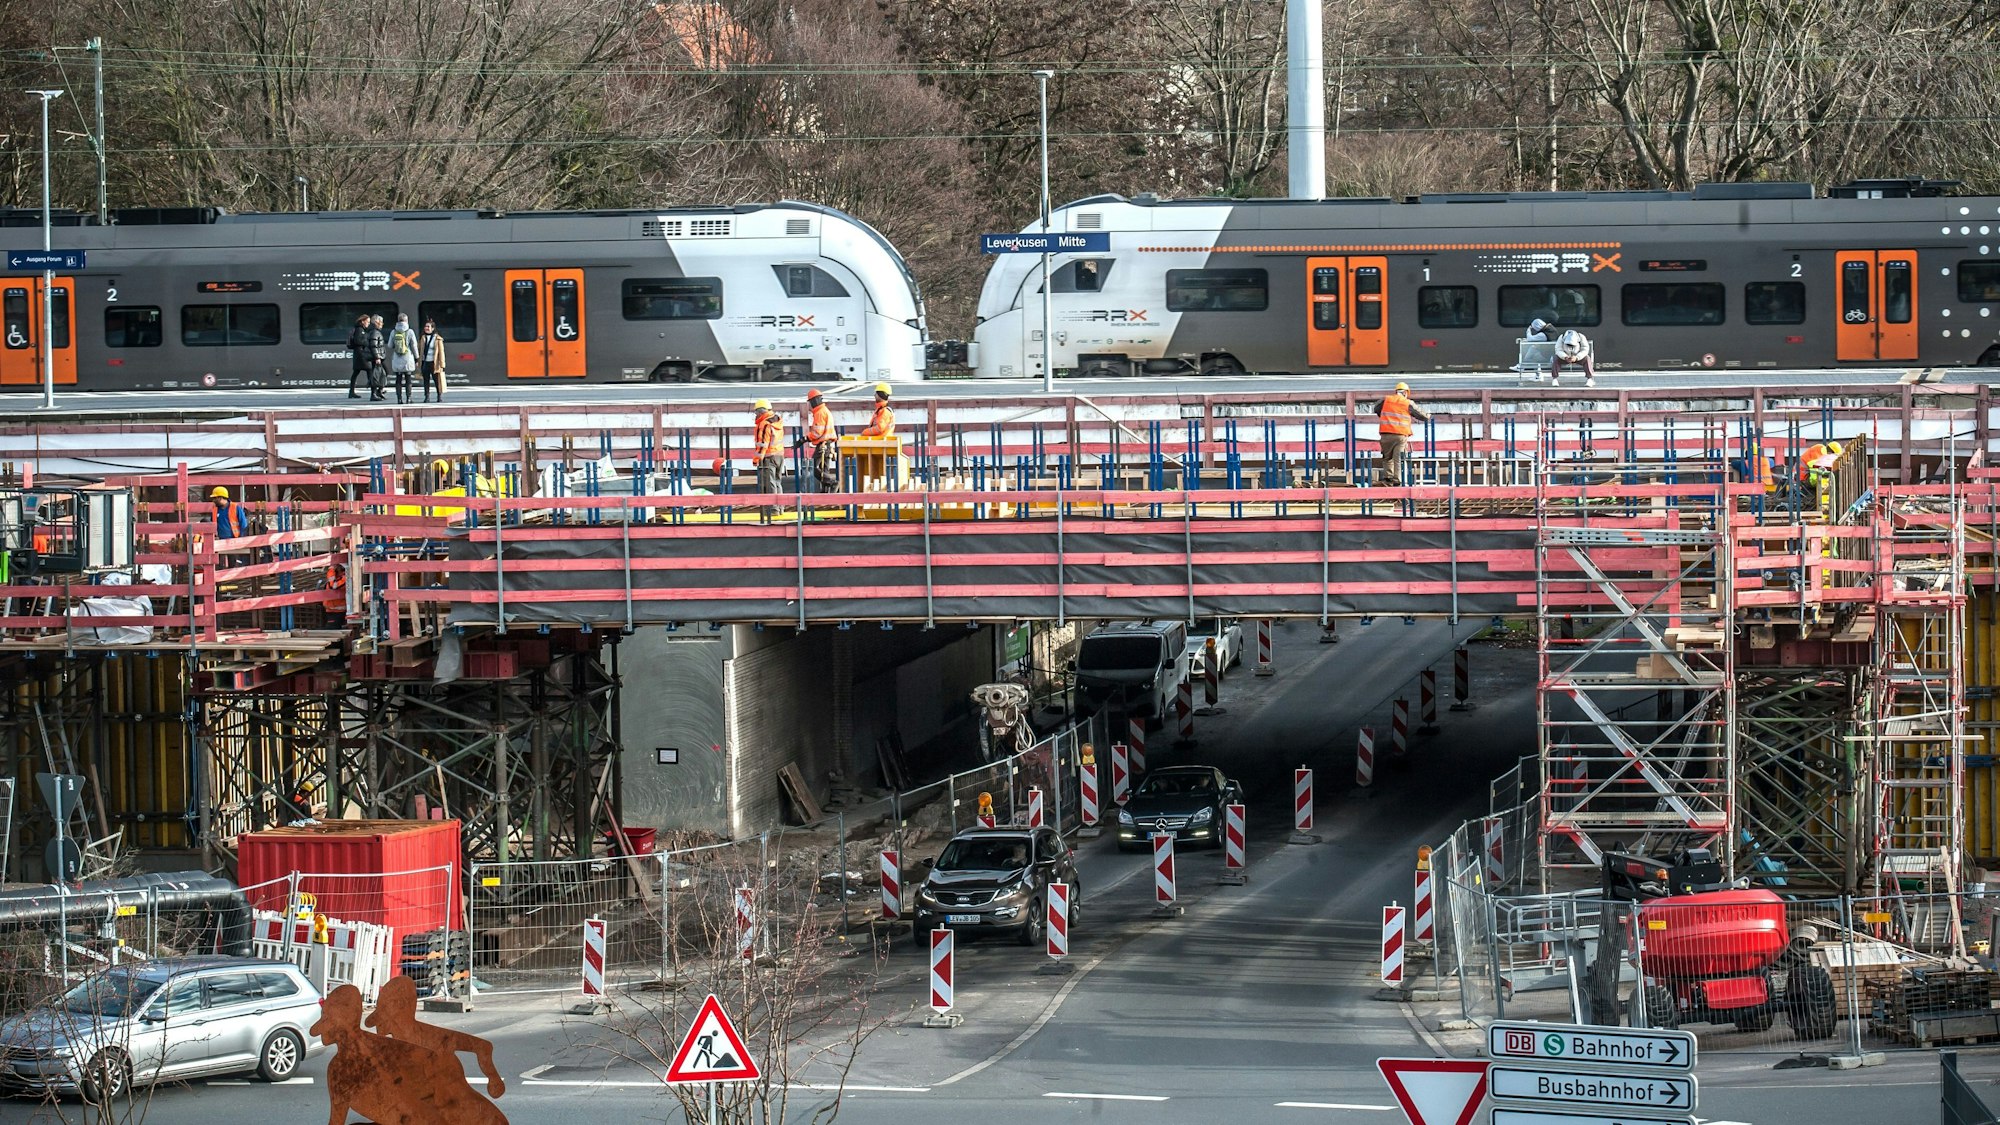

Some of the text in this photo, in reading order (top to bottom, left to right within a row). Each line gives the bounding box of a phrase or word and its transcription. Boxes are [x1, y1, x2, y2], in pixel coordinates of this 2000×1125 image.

[987, 236, 1086, 248] Leverkusen Mitte
[1531, 252, 1622, 273] RRX
[1423, 267, 1431, 281] 1
[1791, 263, 1802, 277] 2
[333, 270, 421, 291] RRX
[107, 288, 118, 302] 2
[462, 282, 473, 296] 2
[760, 315, 815, 328] RRX
[1092, 309, 1147, 322] RRX
[312, 350, 345, 359] national
[1508, 1034, 1532, 1050] DB
[1573, 1037, 1653, 1059] Bahnhof
[1538, 1077, 1654, 1101] Busbahnhof
